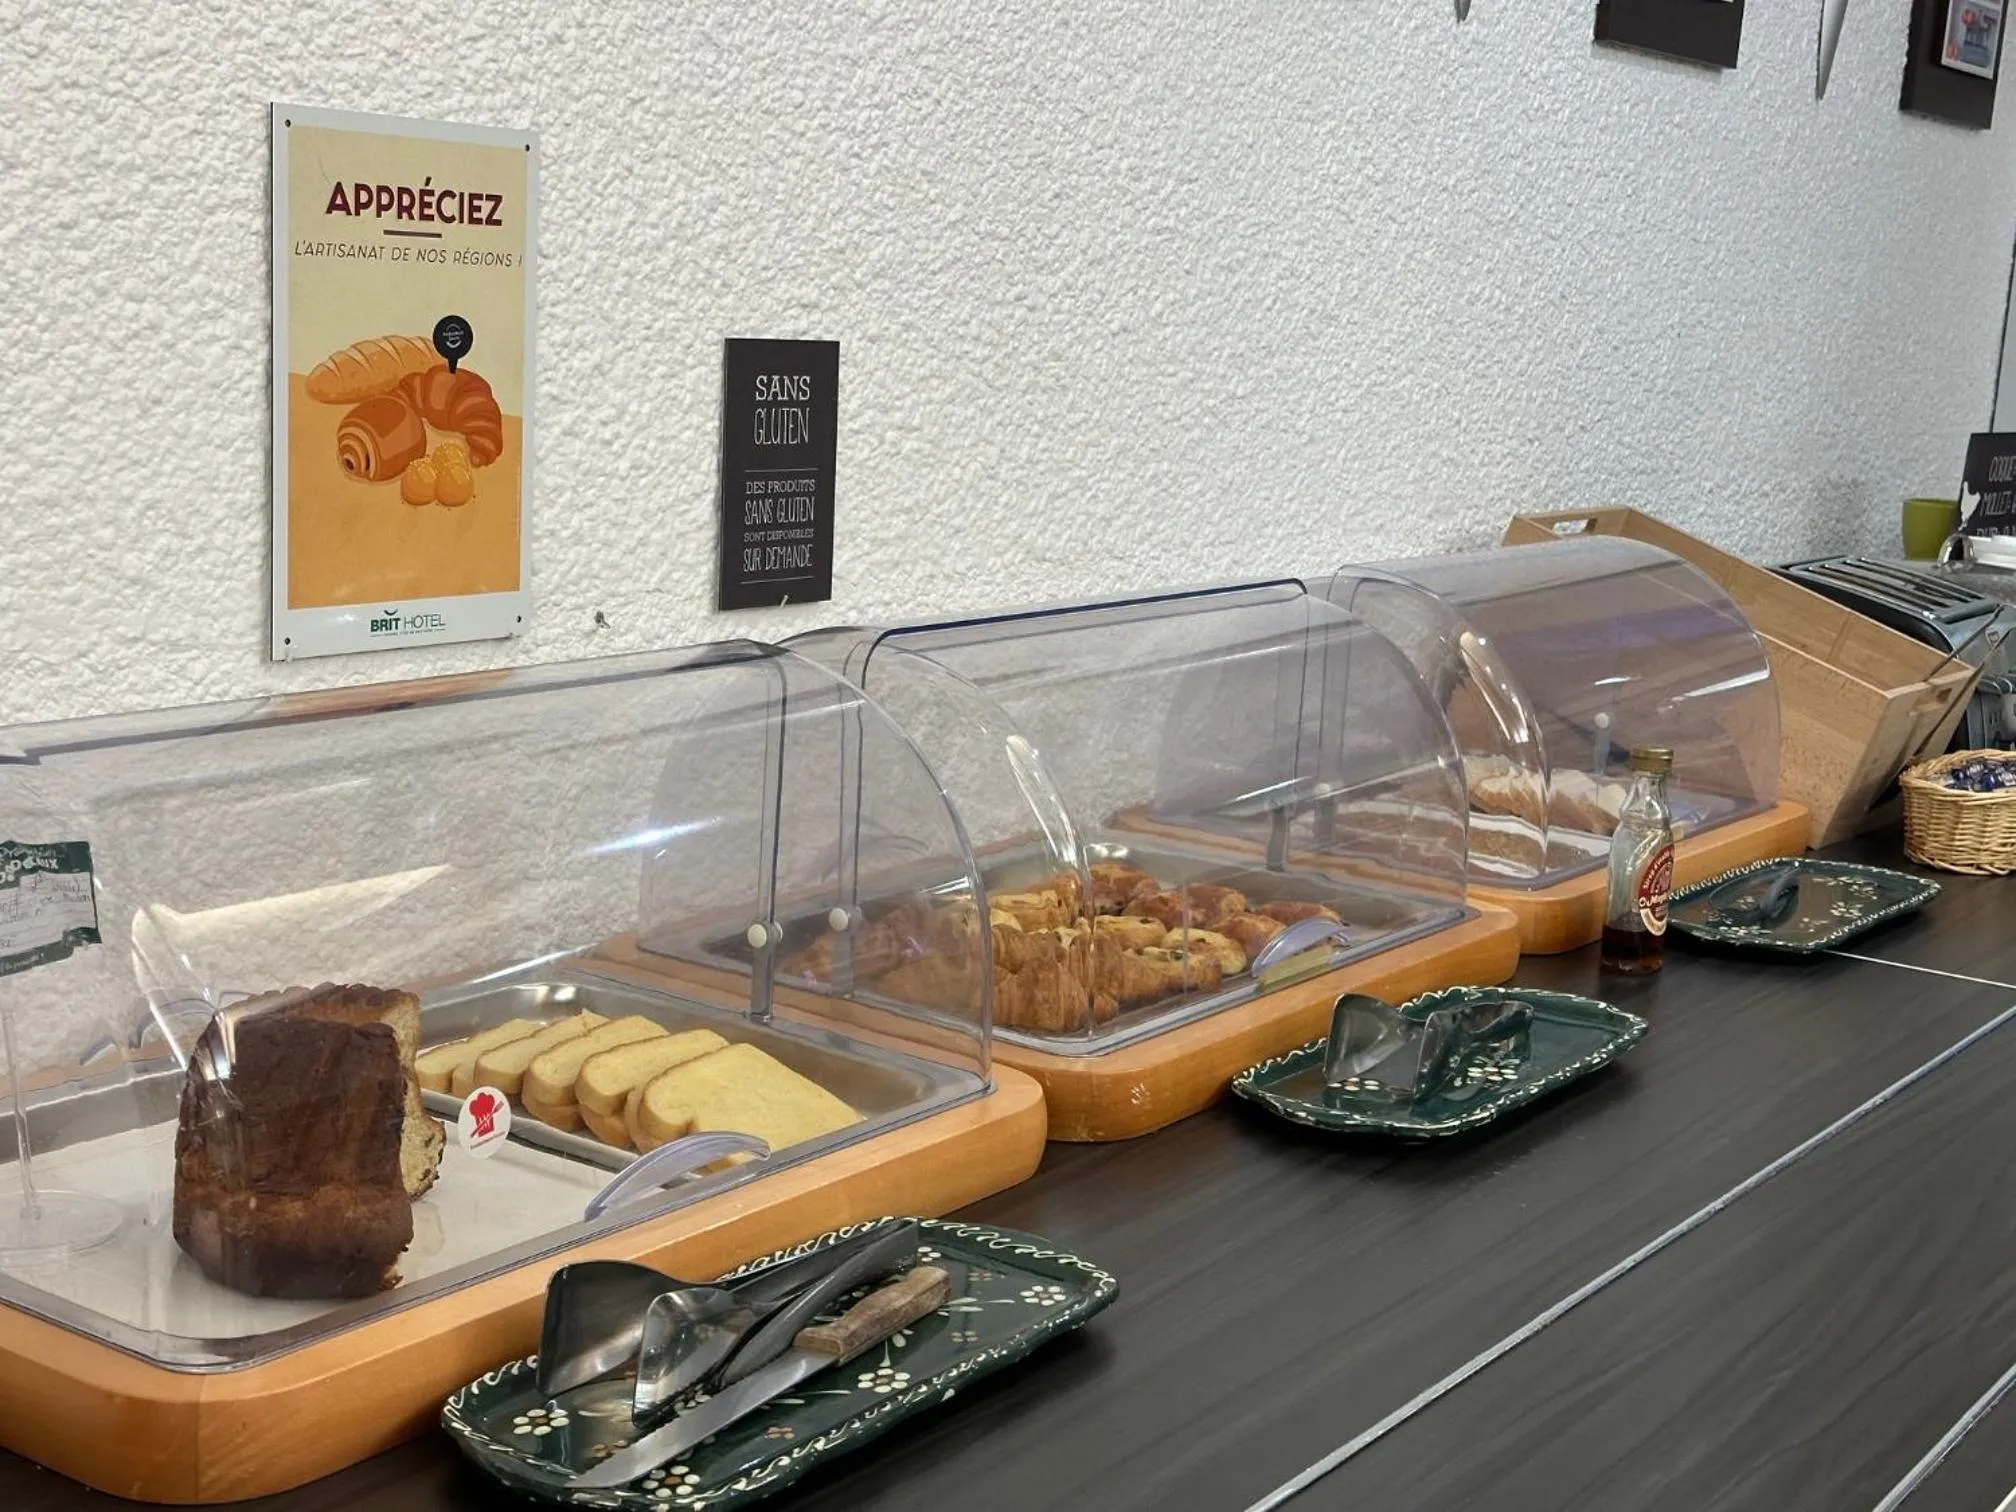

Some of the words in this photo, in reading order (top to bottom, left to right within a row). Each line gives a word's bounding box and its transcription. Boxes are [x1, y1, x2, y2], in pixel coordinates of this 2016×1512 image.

[325, 176, 503, 227] APPRÉCIEZ
[294, 240, 385, 262] L'ARTISANAT
[391, 246, 411, 262] DE
[416, 248, 447, 265] NOS
[453, 246, 513, 267] RÉGIONS
[755, 375, 811, 401] SANS
[754, 407, 810, 445] GLUTEN
[745, 480, 765, 495] DES
[768, 478, 816, 494] PRODUITS
[744, 500, 773, 525] SANS
[777, 496, 815, 524] GLUTEN
[743, 531, 766, 543] SONT
[743, 547, 762, 573] SUR
[765, 543, 813, 571] DEMANDE
[370, 617, 401, 633] BRIT
[404, 613, 446, 630] HOTEL
